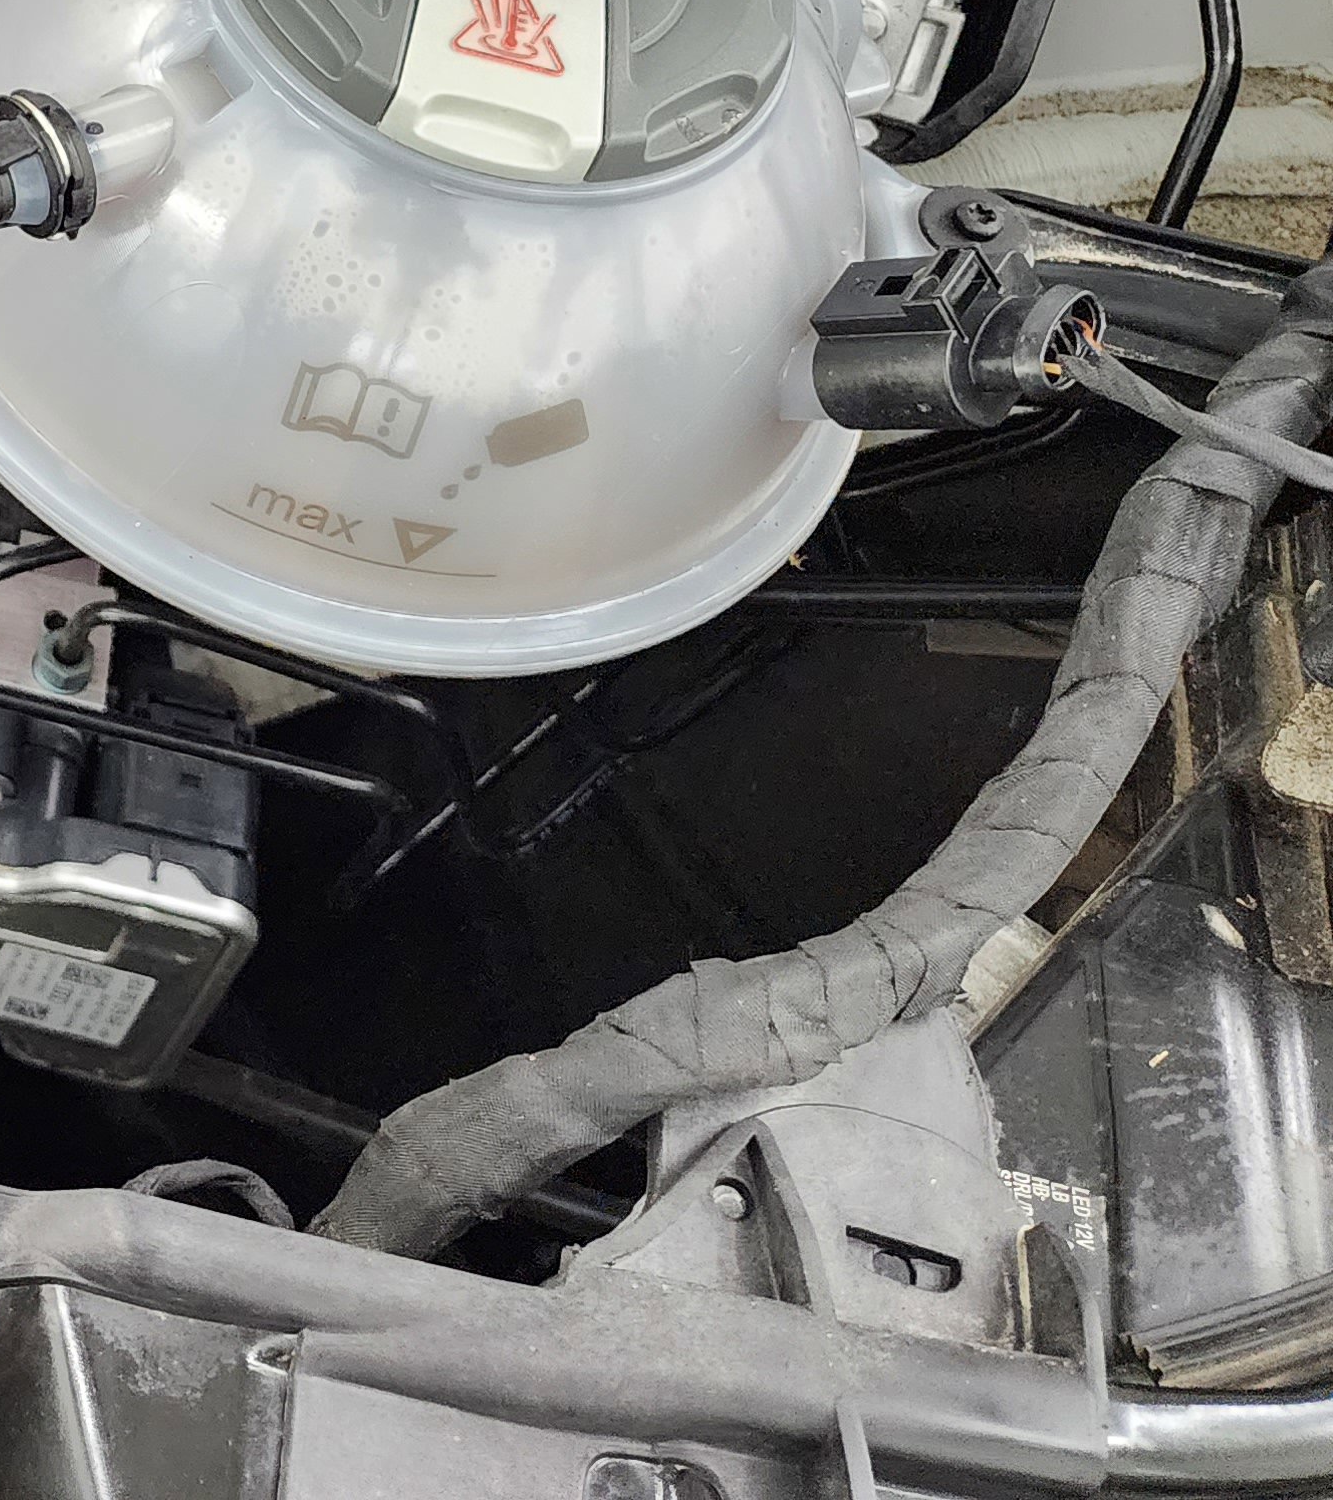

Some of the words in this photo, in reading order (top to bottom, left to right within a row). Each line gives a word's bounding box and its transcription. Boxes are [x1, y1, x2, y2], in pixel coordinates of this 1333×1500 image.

[245, 481, 363, 545] max
[1050, 1181, 1070, 1203] LB
[1071, 1185, 1091, 1218] LED
[1074, 1222, 1096, 1252] 12V
